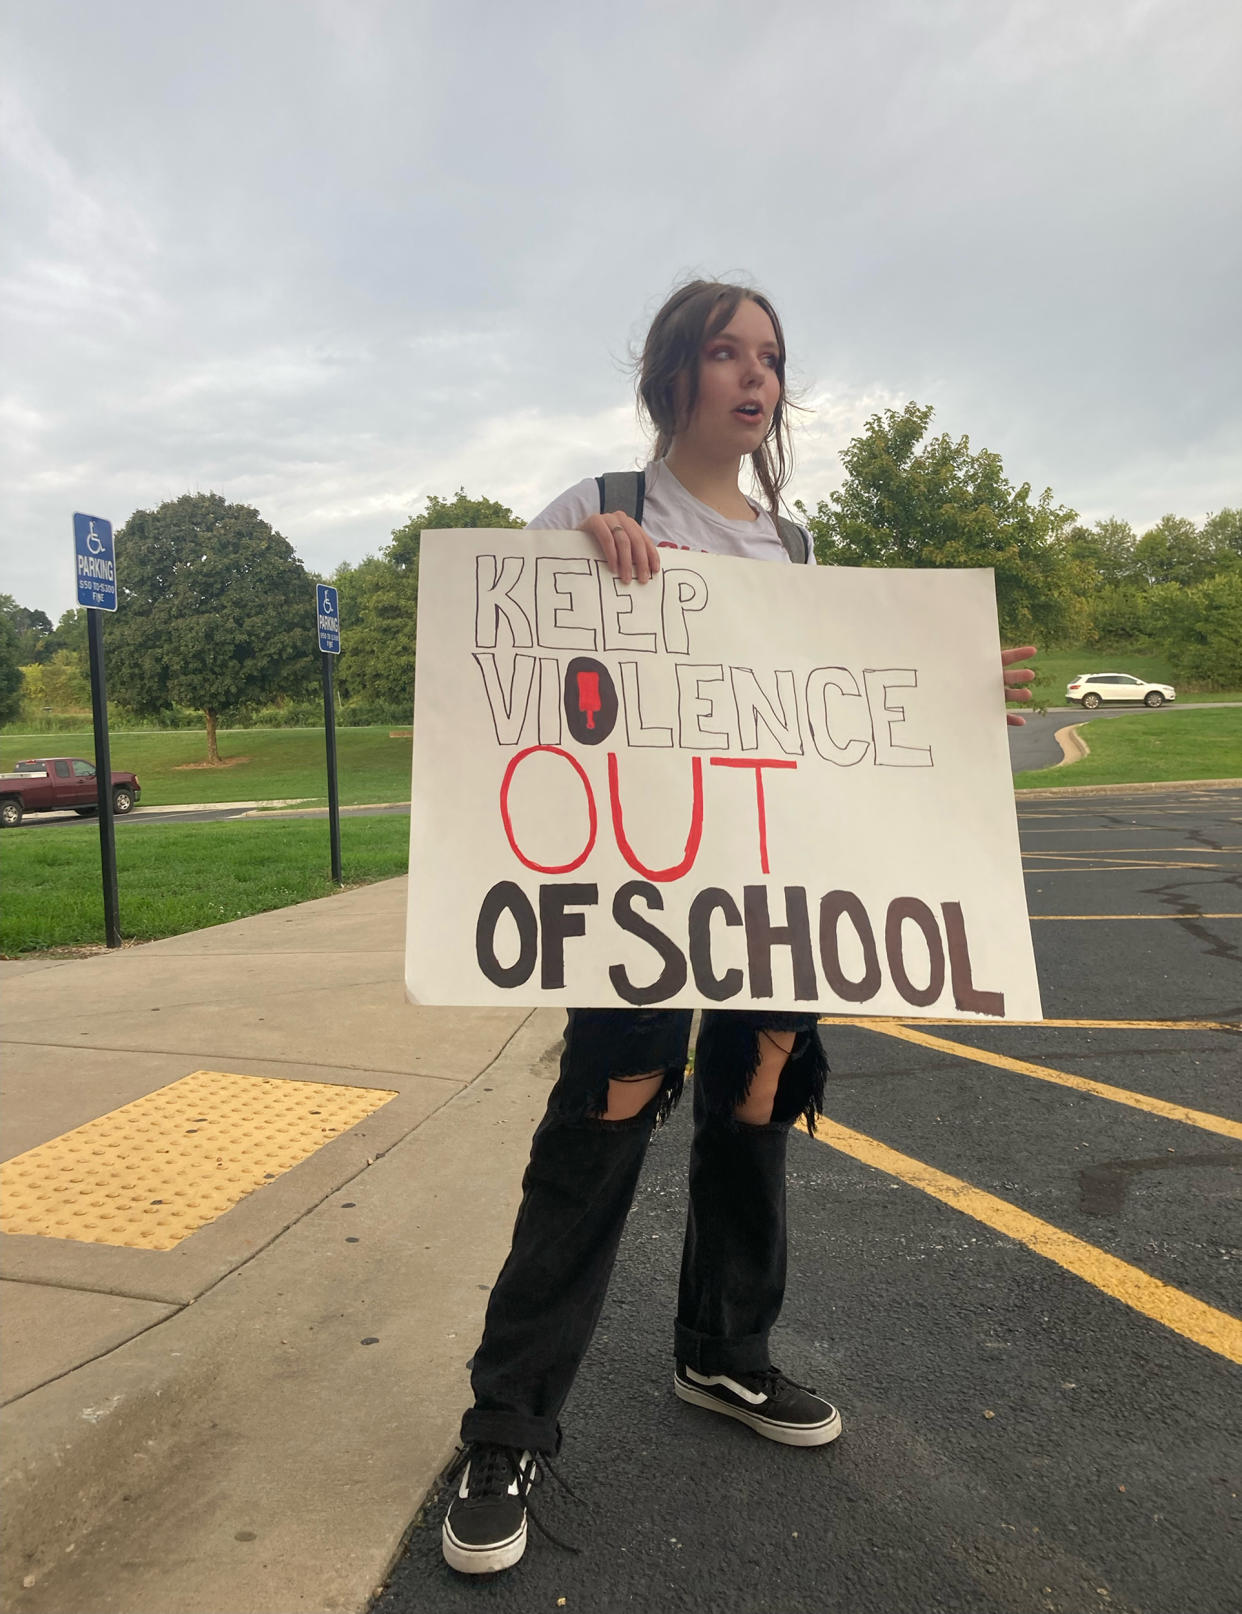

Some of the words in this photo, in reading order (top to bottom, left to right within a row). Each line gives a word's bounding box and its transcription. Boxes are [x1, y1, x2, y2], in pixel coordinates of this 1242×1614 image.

[78, 555, 113, 581] PARKING
[474, 554, 709, 655] KEEP
[320, 615, 338, 632] PARKING
[472, 652, 934, 768] VIOLENCE
[500, 745, 798, 882] OUT
[475, 880, 599, 989] OF
[608, 880, 1005, 1017] SCHOOL
